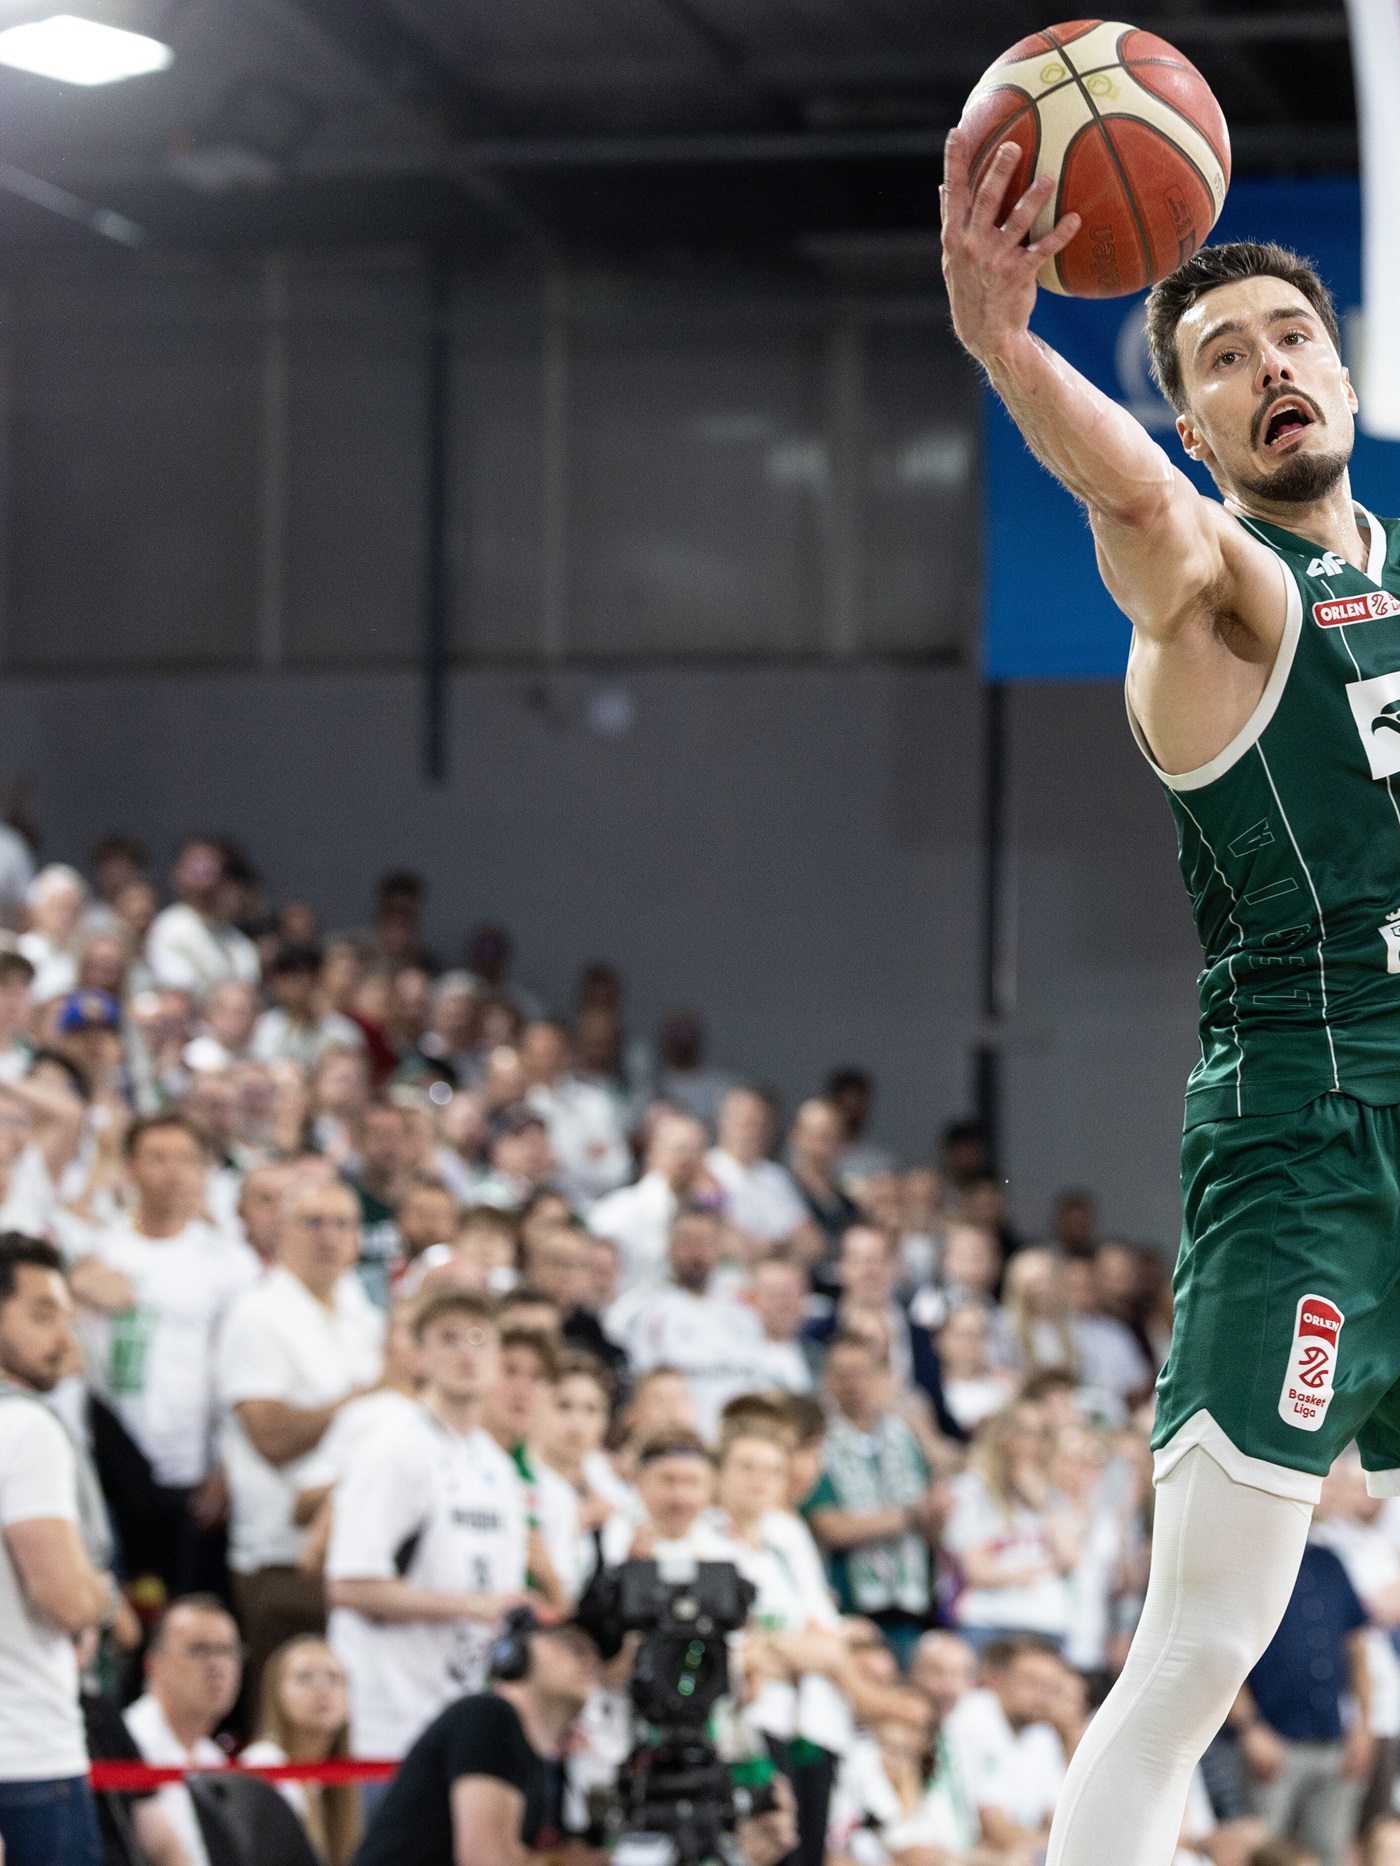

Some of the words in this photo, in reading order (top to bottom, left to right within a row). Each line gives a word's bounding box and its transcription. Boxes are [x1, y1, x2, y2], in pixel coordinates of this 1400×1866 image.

[1320, 601, 1367, 622] ORLEN
[1303, 1312, 1340, 1333] ORLEN
[1288, 1388, 1327, 1408] Basket
[1293, 1402, 1317, 1419] Liga
